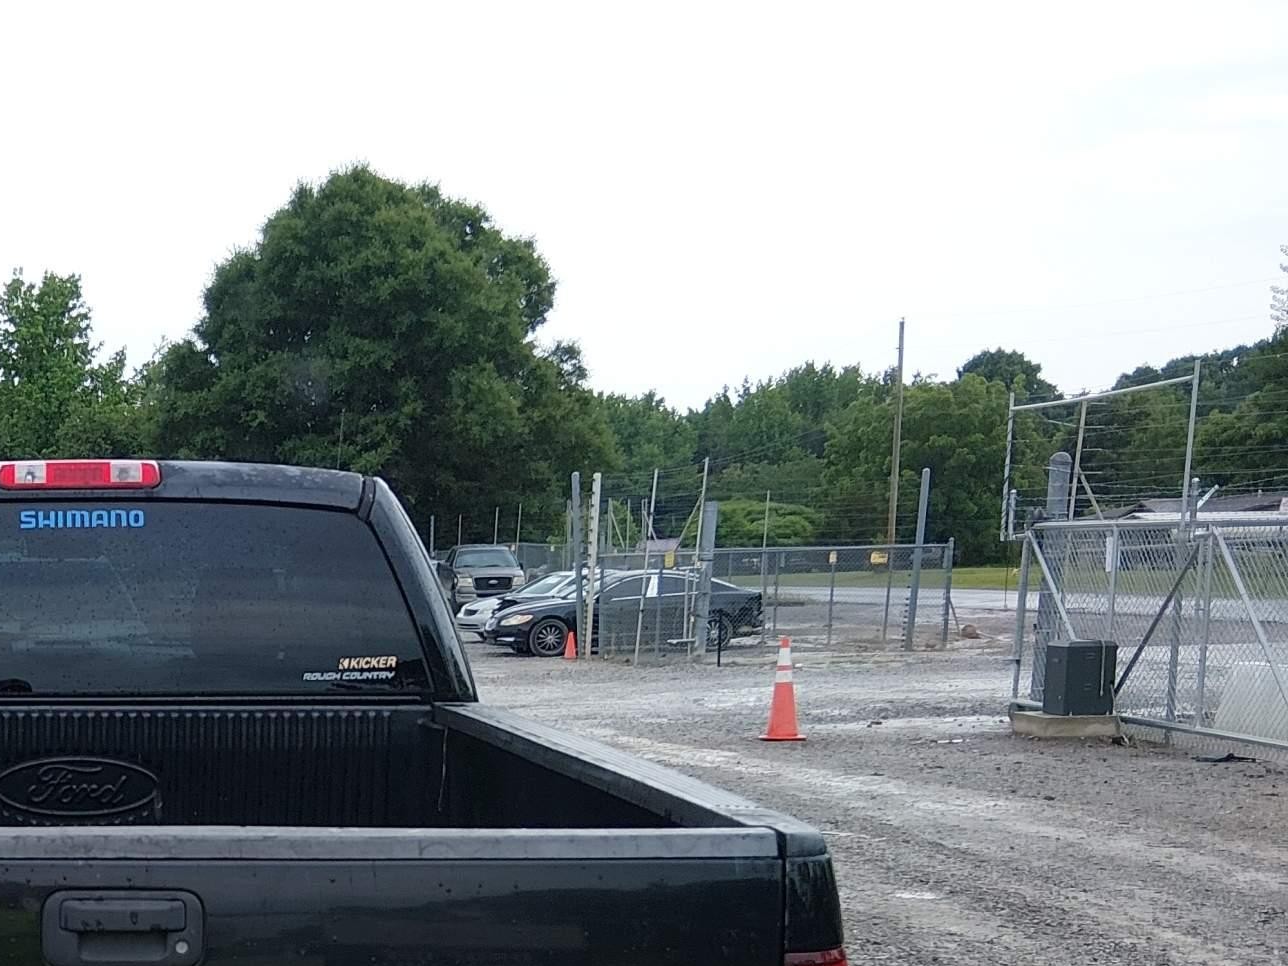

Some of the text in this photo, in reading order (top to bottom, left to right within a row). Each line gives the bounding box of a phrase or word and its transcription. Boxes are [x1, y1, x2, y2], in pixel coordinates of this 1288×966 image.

[19, 509, 145, 529] SHIMANO
[349, 655, 398, 670] KICKER
[302, 671, 396, 681] ROUGH COUNTRY
[28, 764, 127, 803] Ford
